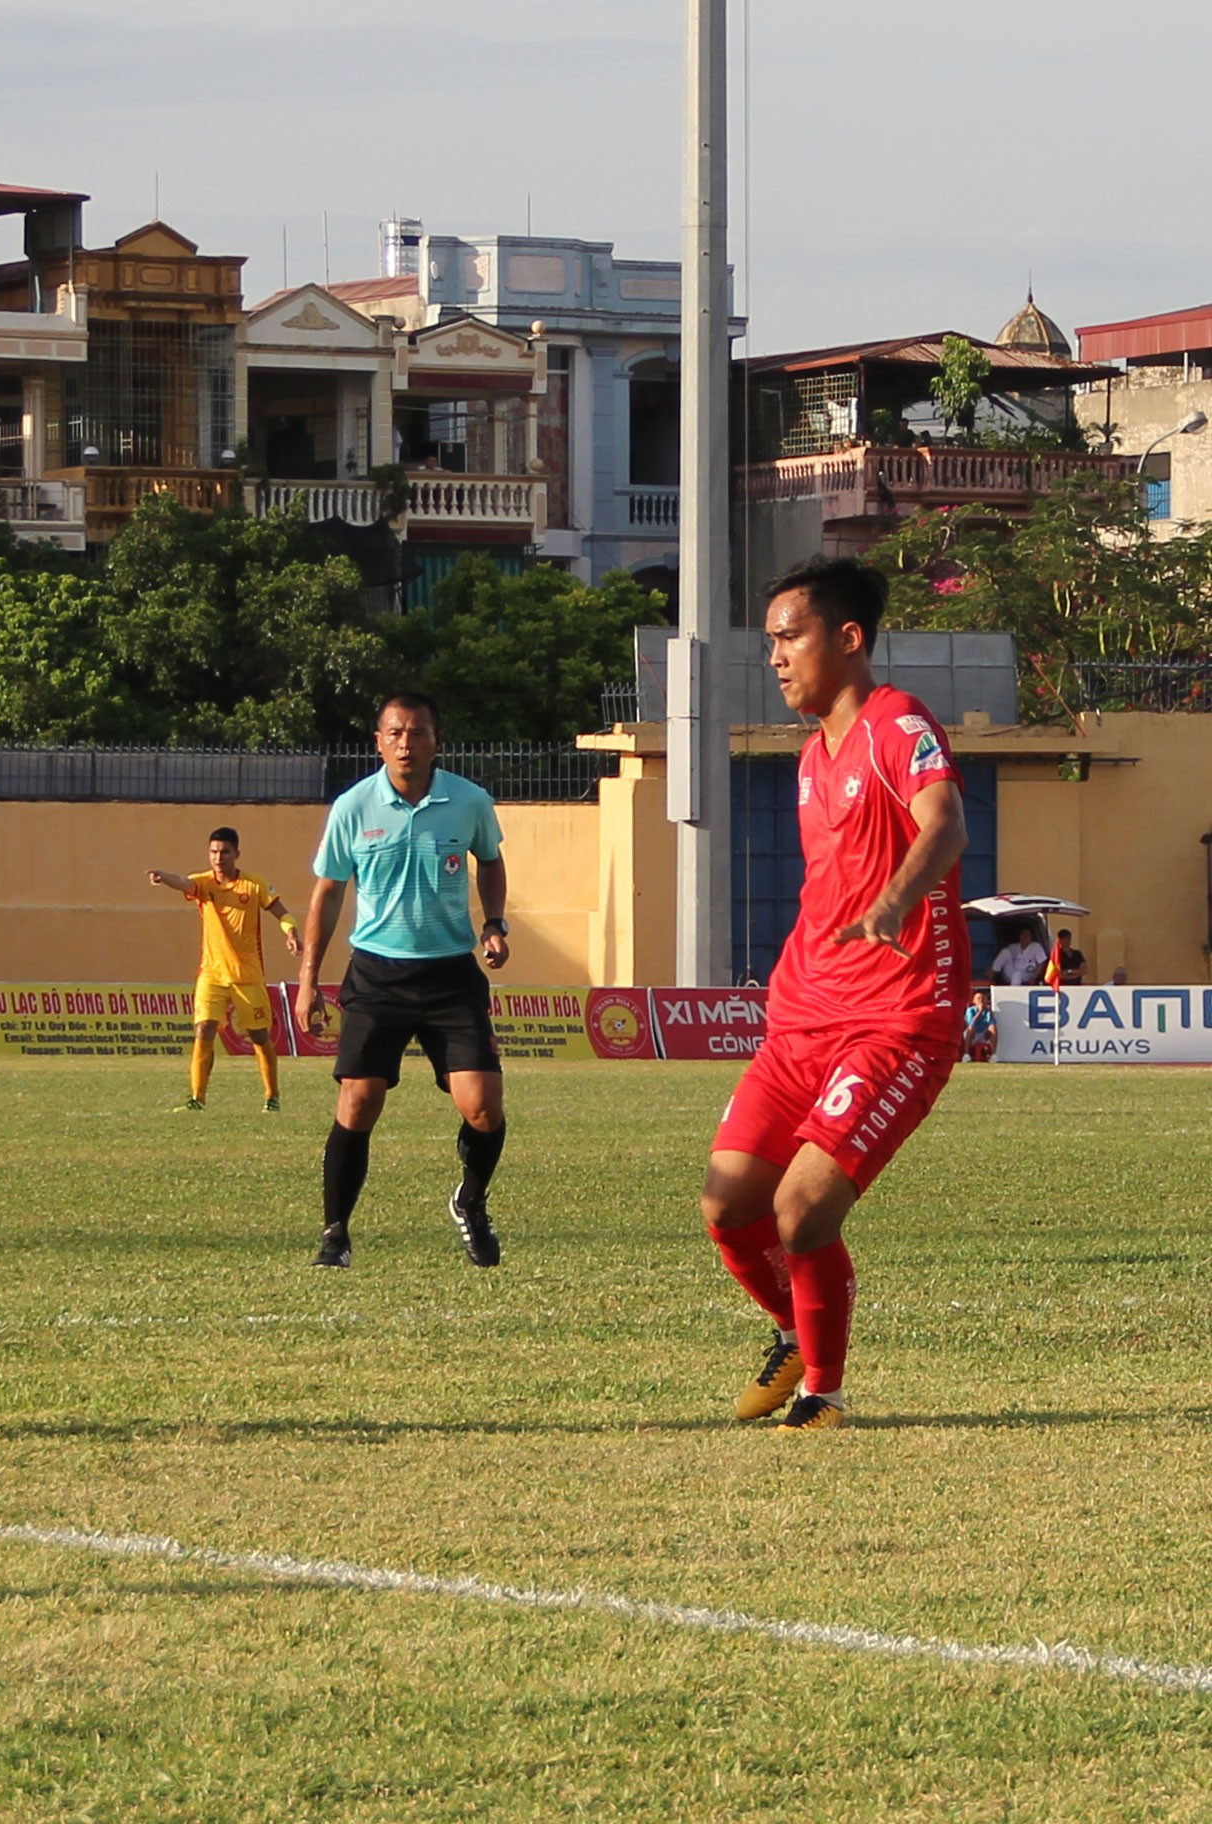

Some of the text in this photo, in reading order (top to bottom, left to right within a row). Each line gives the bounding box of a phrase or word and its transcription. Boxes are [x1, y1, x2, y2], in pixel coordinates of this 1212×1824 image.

[11, 992, 38, 1019] LẠC
[41, 987, 62, 1019] BỘ
[65, 988, 105, 1015] BÓNG
[108, 989, 129, 1015] ĐÁ
[131, 993, 178, 1015] THANH
[505, 994, 549, 1017] THANH
[553, 991, 581, 1017] HÓA
[662, 1001, 693, 1024] XI
[1028, 989, 1212, 1033] BAM
[1031, 1039, 1151, 1055] AIRWAYS
